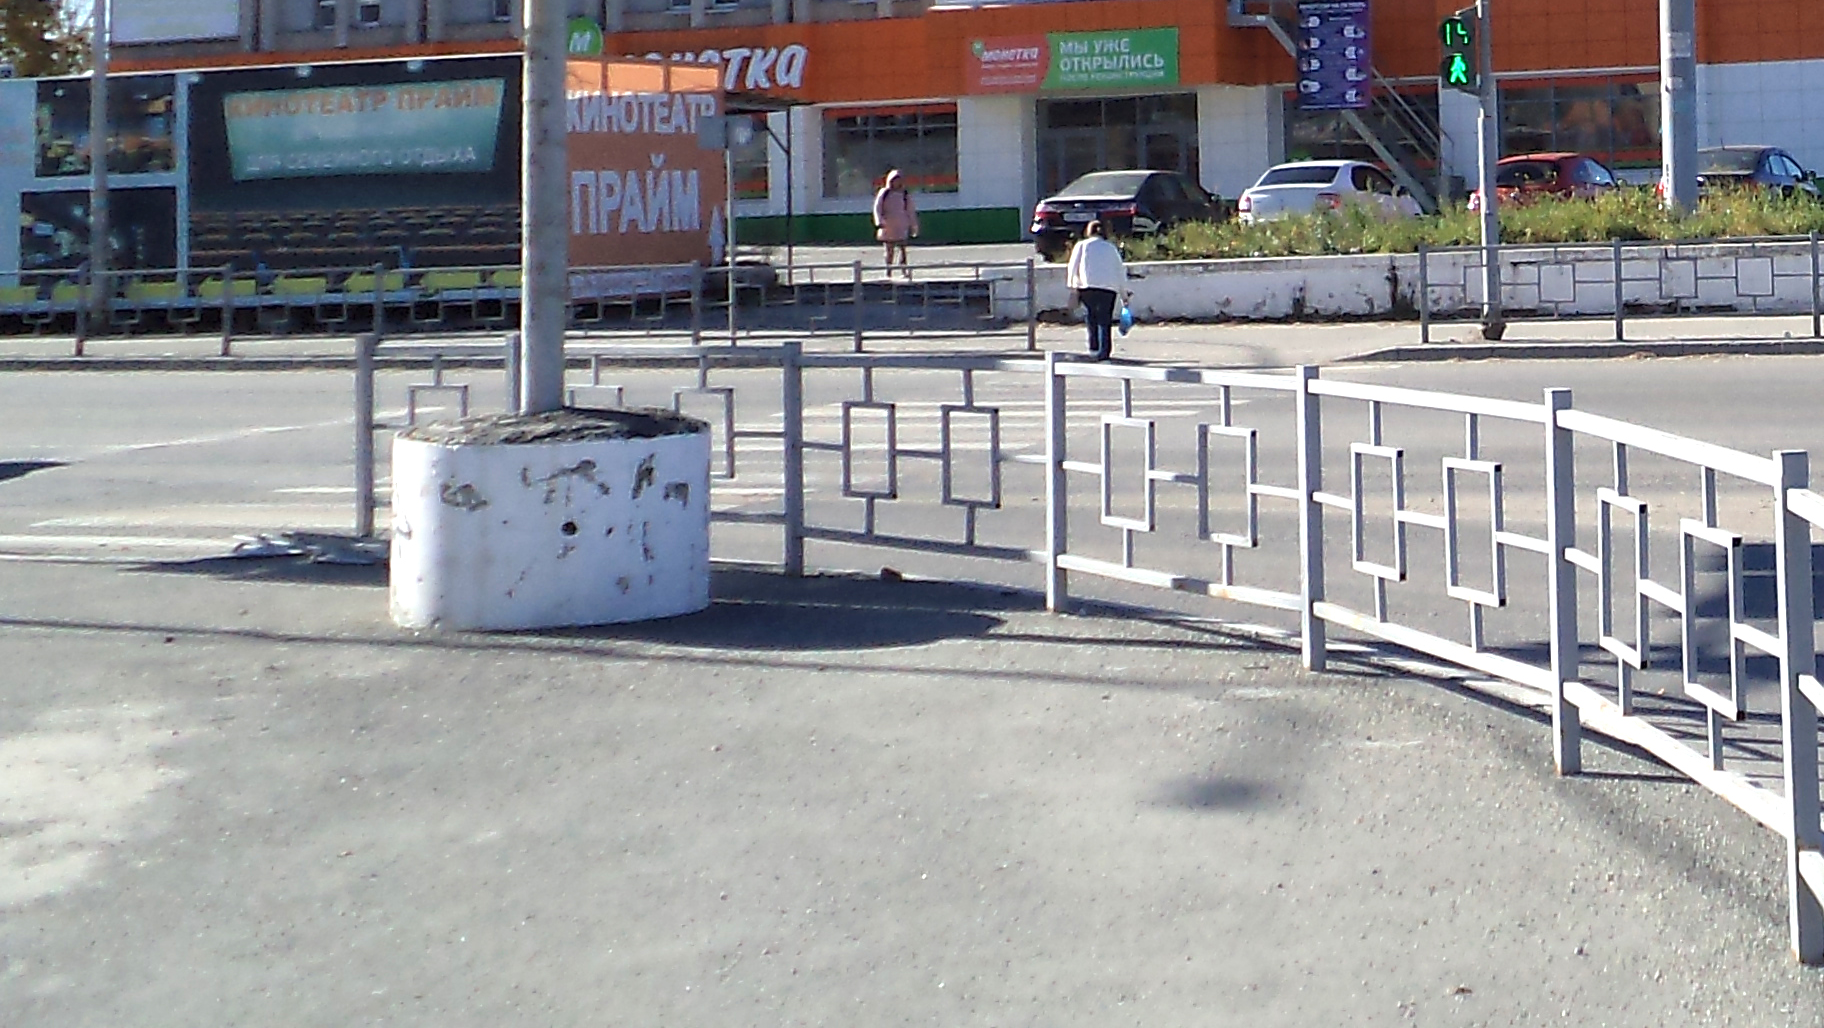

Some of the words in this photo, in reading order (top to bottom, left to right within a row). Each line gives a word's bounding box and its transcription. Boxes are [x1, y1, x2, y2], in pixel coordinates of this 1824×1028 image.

[1059, 40, 1088, 54] МЫ
[1093, 38, 1130, 54] УЖЕ
[1059, 53, 1165, 72] ОТКРЫЛИСЬ
[566, 91, 717, 134] КИНОТЕАТР
[571, 153, 700, 234] ПРАЙМ
